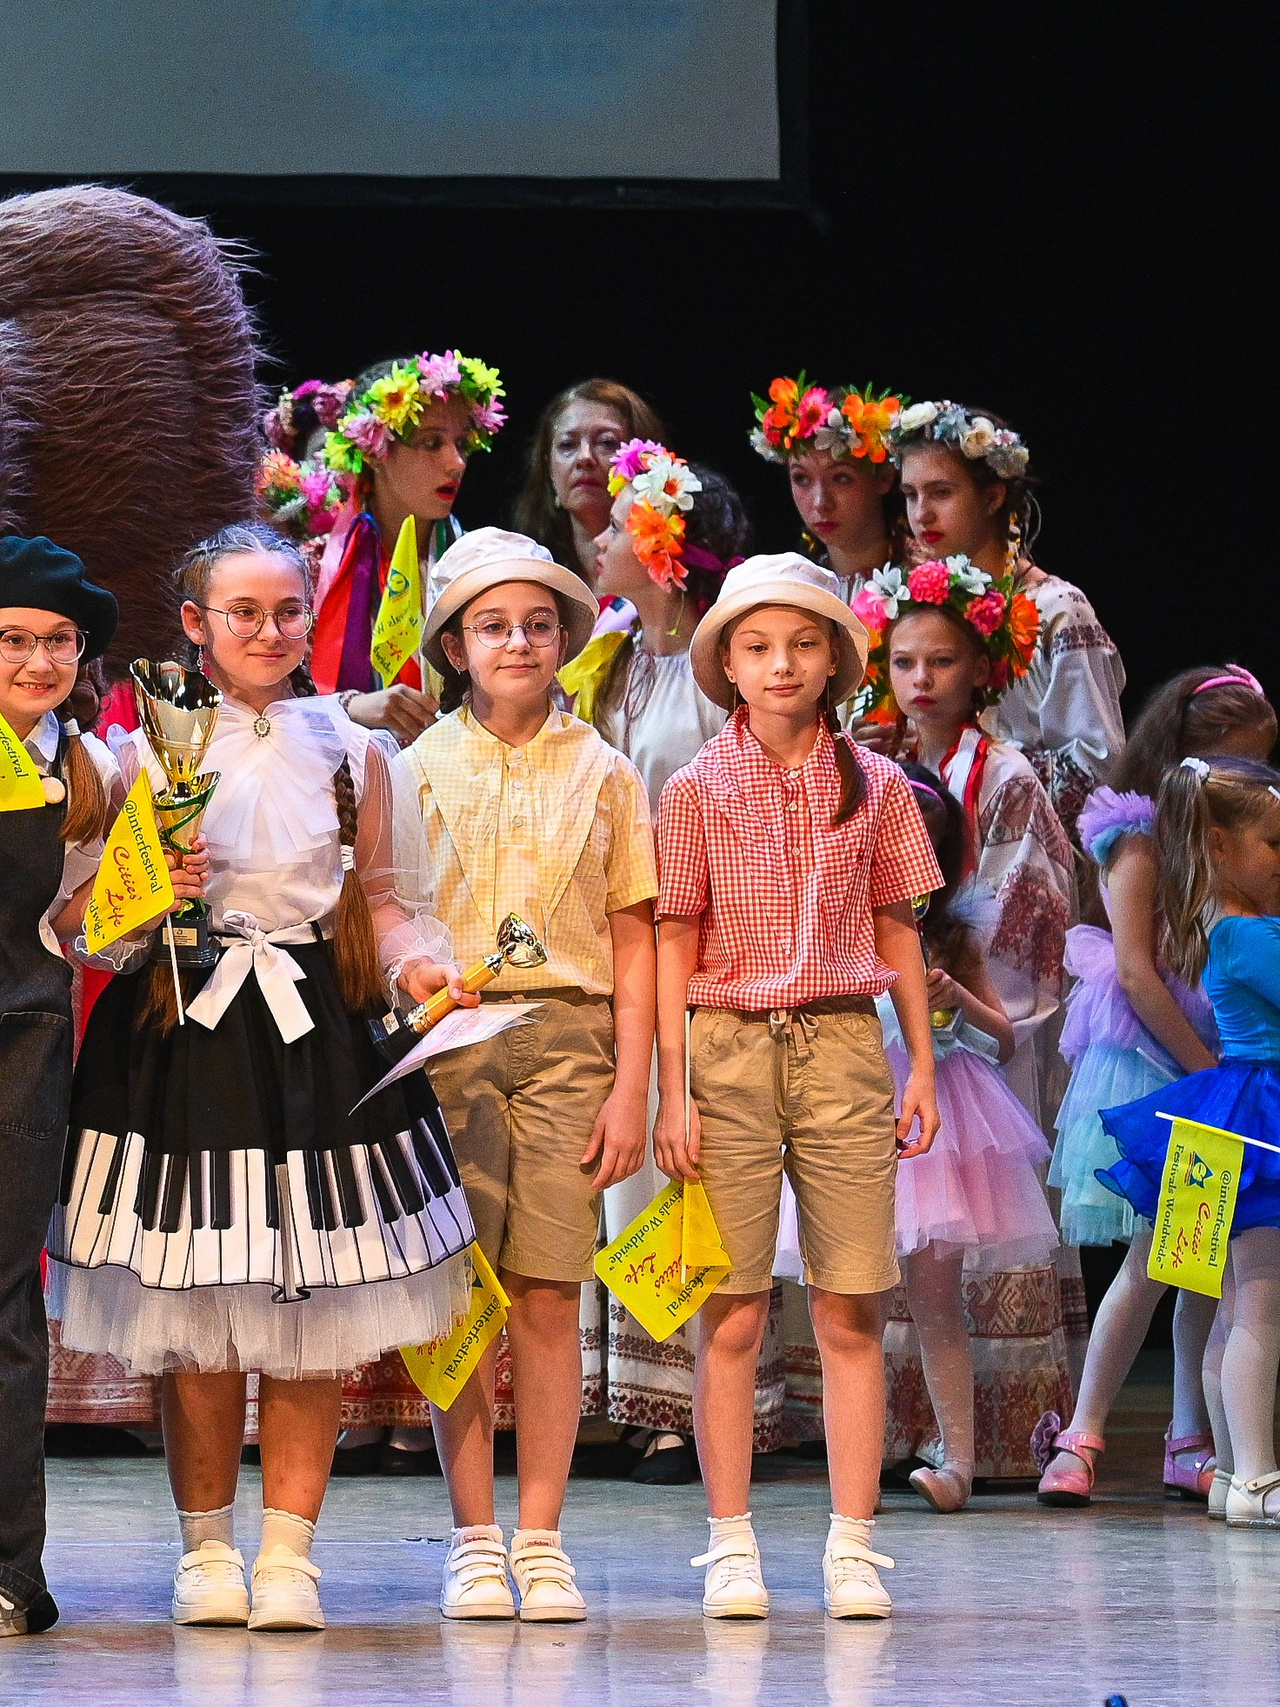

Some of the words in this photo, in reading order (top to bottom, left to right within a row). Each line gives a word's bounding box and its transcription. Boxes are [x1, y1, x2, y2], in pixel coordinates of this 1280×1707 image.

[122, 800, 163, 894] @interfestival
[105, 888, 125, 927] Life
[1168, 1144, 1184, 1195] Festivals
[1208, 1170, 1232, 1267] @interfestival
[624, 1252, 656, 1284] Life
[1171, 1227, 1188, 1268] Life
[443, 1294, 502, 1380] @interfestival
